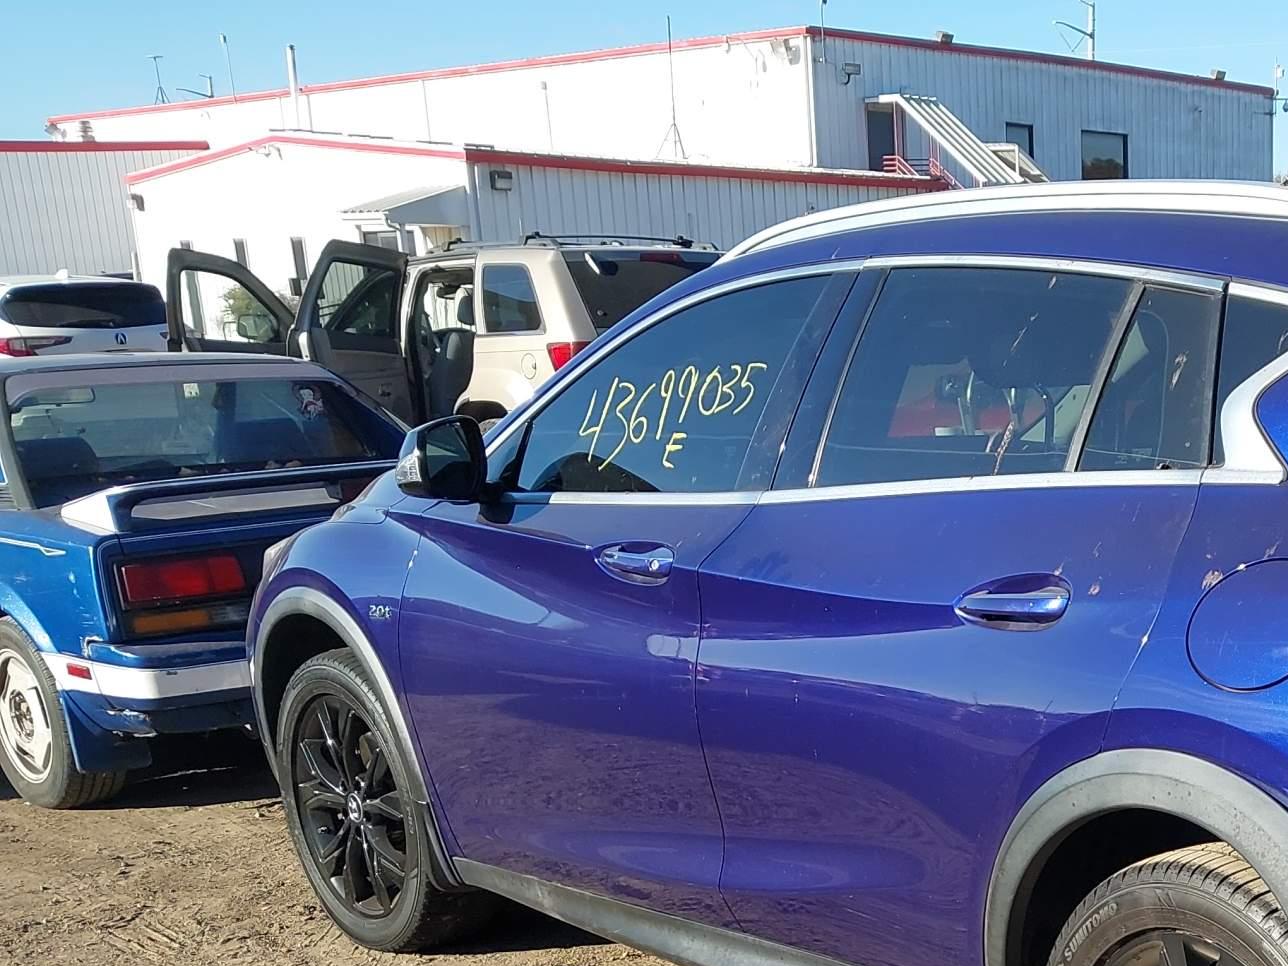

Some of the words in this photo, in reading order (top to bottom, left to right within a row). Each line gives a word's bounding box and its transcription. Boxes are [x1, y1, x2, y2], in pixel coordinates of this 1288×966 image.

[578, 362, 768, 471] 43699035
[661, 431, 688, 470] E
[1063, 902, 1119, 962] SUMITOMO
